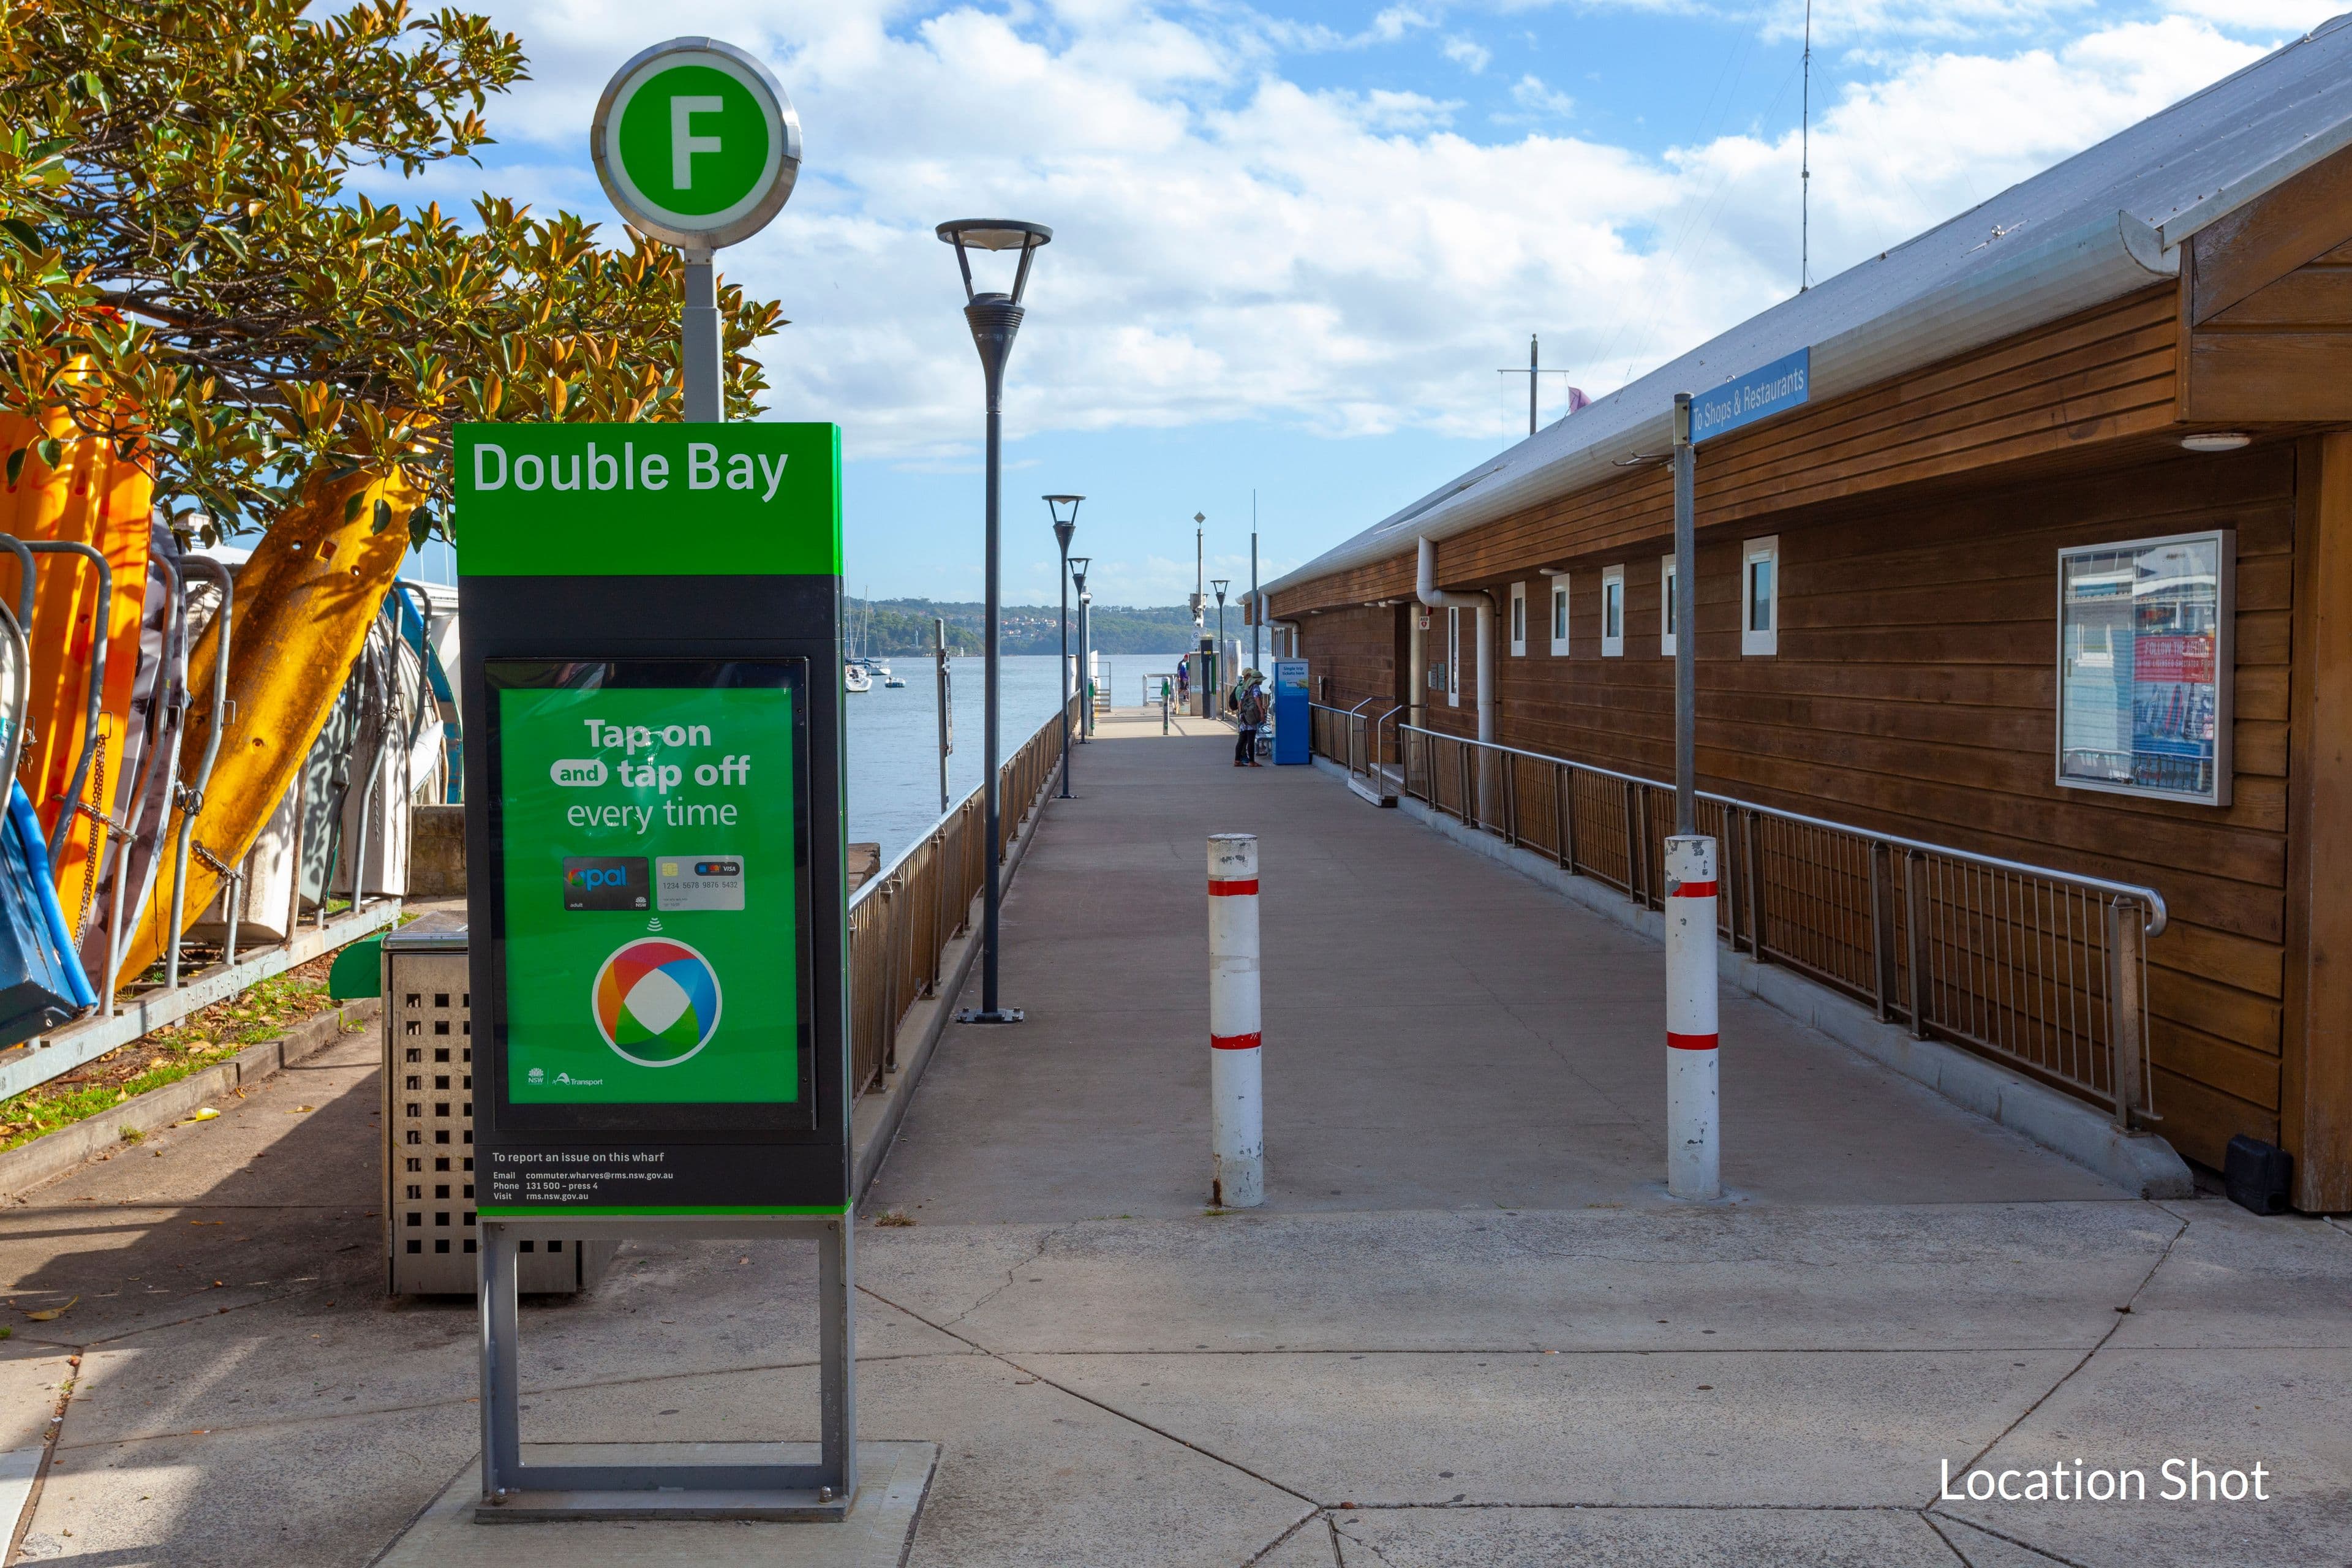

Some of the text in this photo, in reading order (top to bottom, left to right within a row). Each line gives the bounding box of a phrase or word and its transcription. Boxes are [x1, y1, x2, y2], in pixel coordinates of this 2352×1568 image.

[671, 96, 723, 190] F
[1694, 369, 1804, 431] To Shops & Restaurants
[474, 442, 789, 503] Double Bay
[2144, 641, 2171, 655] FOLLOW
[2174, 641, 2185, 655] THE
[584, 719, 711, 755] Tap on
[560, 755, 750, 794] and tap off
[567, 796, 737, 835] every time
[492, 1153, 505, 1162] To
[508, 1153, 543, 1164] report
[561, 1153, 590, 1162] issue
[609, 1153, 630, 1162] this
[632, 1153, 665, 1162] wharf
[526, 1172, 673, 1180] commuter.wharves@rms.nsw.gov.au
